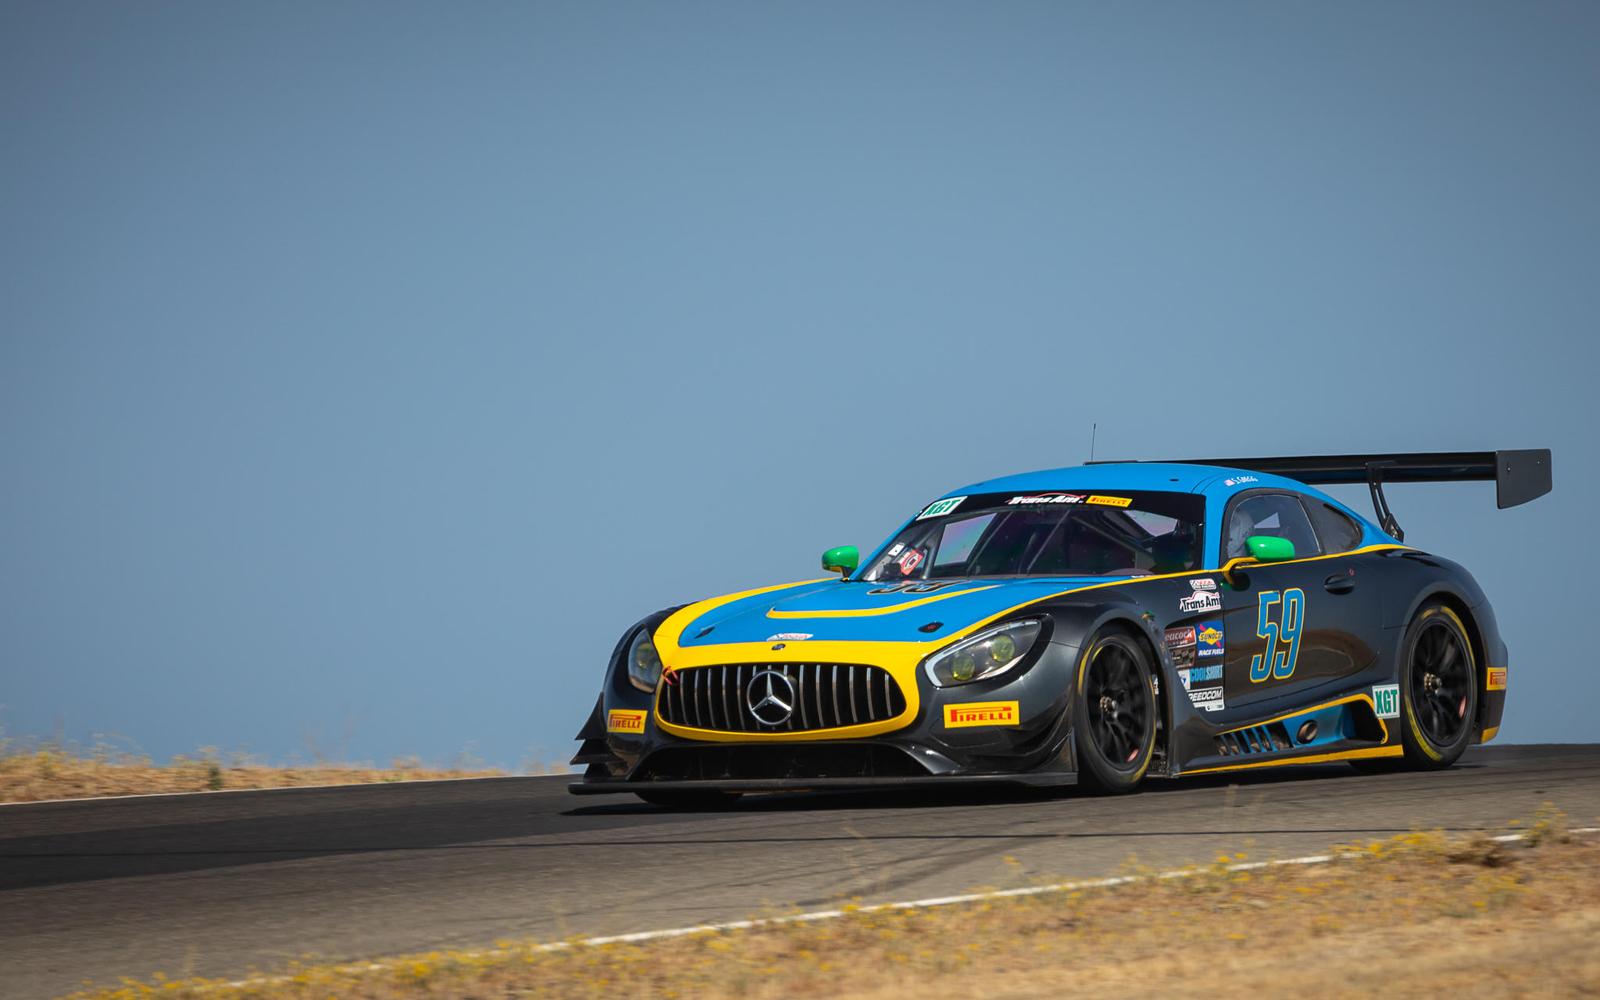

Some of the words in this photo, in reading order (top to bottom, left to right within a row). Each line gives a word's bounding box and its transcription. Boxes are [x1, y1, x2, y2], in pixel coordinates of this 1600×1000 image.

[922, 499, 961, 517] XGT
[1182, 600, 1205, 610] Trans
[1205, 596, 1220, 607] Am
[1199, 631, 1222, 641] SUNOCO
[1250, 587, 1305, 683] 59
[1188, 689, 1222, 702] PEEDCOM
[1375, 689, 1397, 714] XGT
[609, 713, 642, 728] PIRELLI
[949, 705, 1012, 722] PIRELLI
